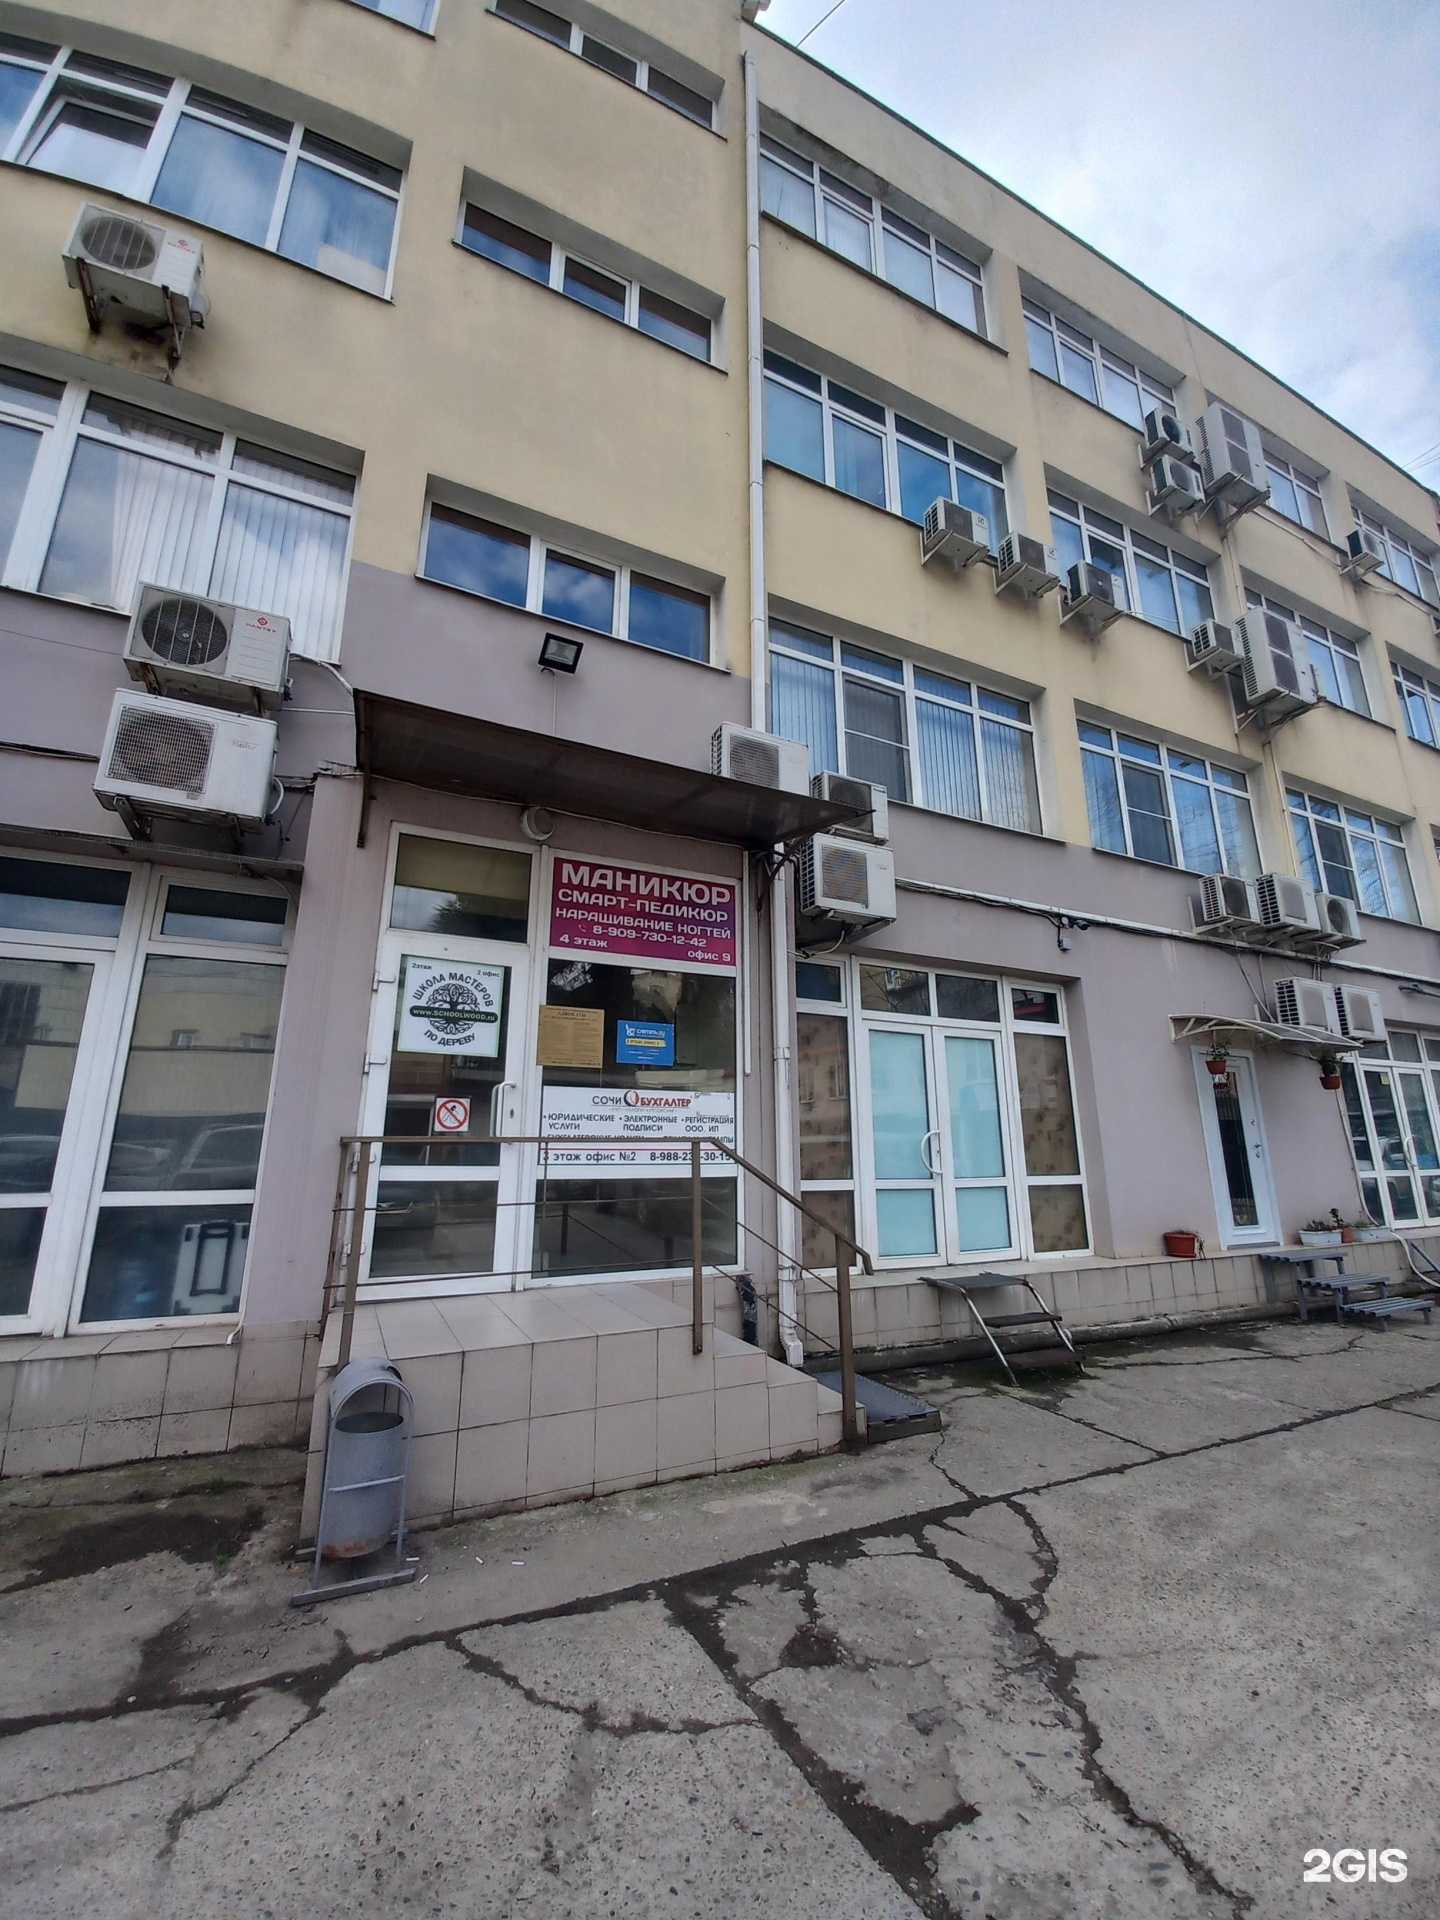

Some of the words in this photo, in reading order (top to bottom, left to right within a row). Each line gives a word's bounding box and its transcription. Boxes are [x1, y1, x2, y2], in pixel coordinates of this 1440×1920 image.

[562, 863, 730, 905] МАНИКЮР
[558, 889, 728, 923] СМАРТ-ПЕДИКЮР
[593, 926, 707, 947] 8-909-730-12-42
[678, 923, 731, 939] НОГТЕЙ
[559, 934, 570, 943] 4
[574, 936, 608, 948] этаж
[688, 950, 719, 961] офис
[722, 953, 731, 961] 9
[412, 973, 446, 1001] ШКОЛА
[449, 972, 494, 1007] МАСТЕРОВ
[424, 1029, 438, 1041] ПО
[438, 1032, 475, 1047] ДЕРЕВУ
[592, 1095, 622, 1105] СОЧИ
[640, 1097, 692, 1107] БУХГАЛТЕР
[549, 1113, 614, 1122] ЮРИДИЧЕСКИЕ
[624, 1115, 677, 1124] ЭЛЕКТРОННЫЕ
[685, 1116, 734, 1125] РЕГИСТРАЦИЯ
[549, 1122, 580, 1131] УСЛУГИ
[623, 1124, 663, 1132] ПОДПИСИ
[708, 1124, 719, 1132] ИП
[553, 1152, 581, 1161] этаж
[585, 1151, 615, 1163] офис
[619, 1151, 636, 1161] №2
[650, 1151, 731, 1161] 8-988-23-30-15
